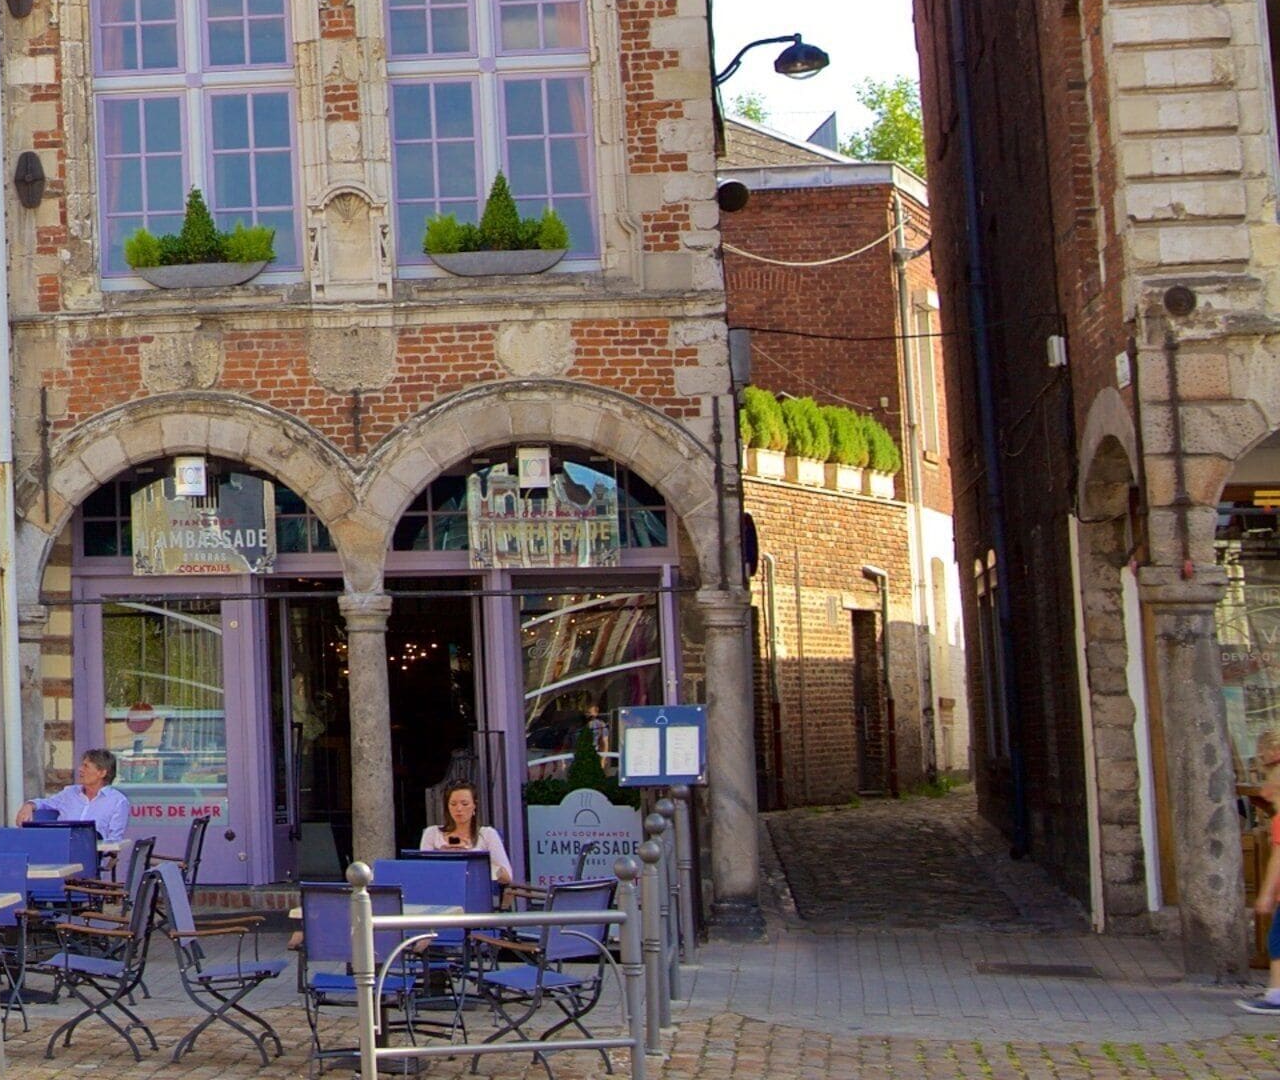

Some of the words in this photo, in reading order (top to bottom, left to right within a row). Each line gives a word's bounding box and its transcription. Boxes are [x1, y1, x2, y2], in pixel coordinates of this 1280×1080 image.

[137, 528, 268, 549] L'AMBASSADE
[178, 563, 231, 573] COCKTAILS
[129, 805, 163, 818] UITS
[167, 805, 186, 818] DE
[190, 805, 221, 818] MER
